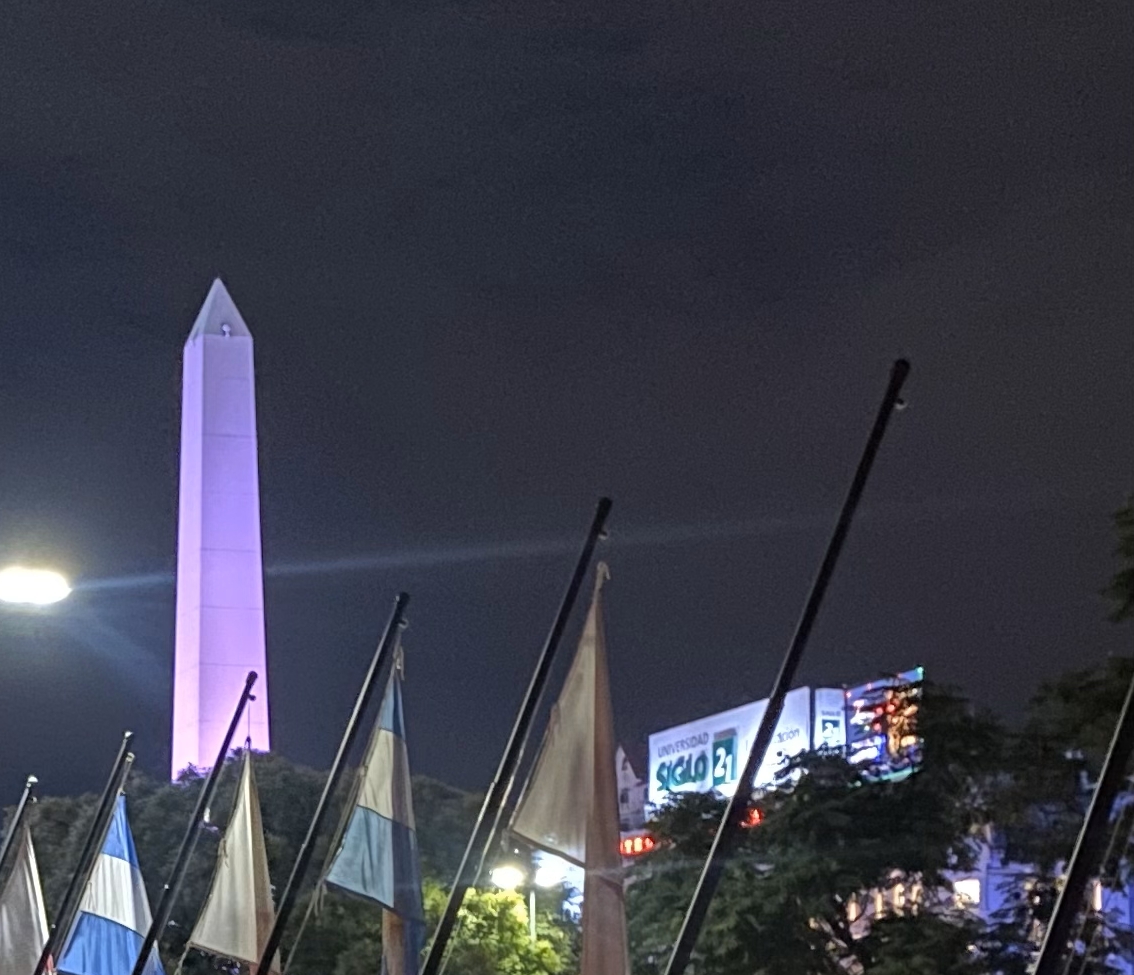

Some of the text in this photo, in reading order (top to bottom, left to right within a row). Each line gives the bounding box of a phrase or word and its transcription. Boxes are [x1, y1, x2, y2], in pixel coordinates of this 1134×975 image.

[657, 731, 710, 758] UNIVERSIDAD
[656, 746, 733, 792] SIGLO 21
